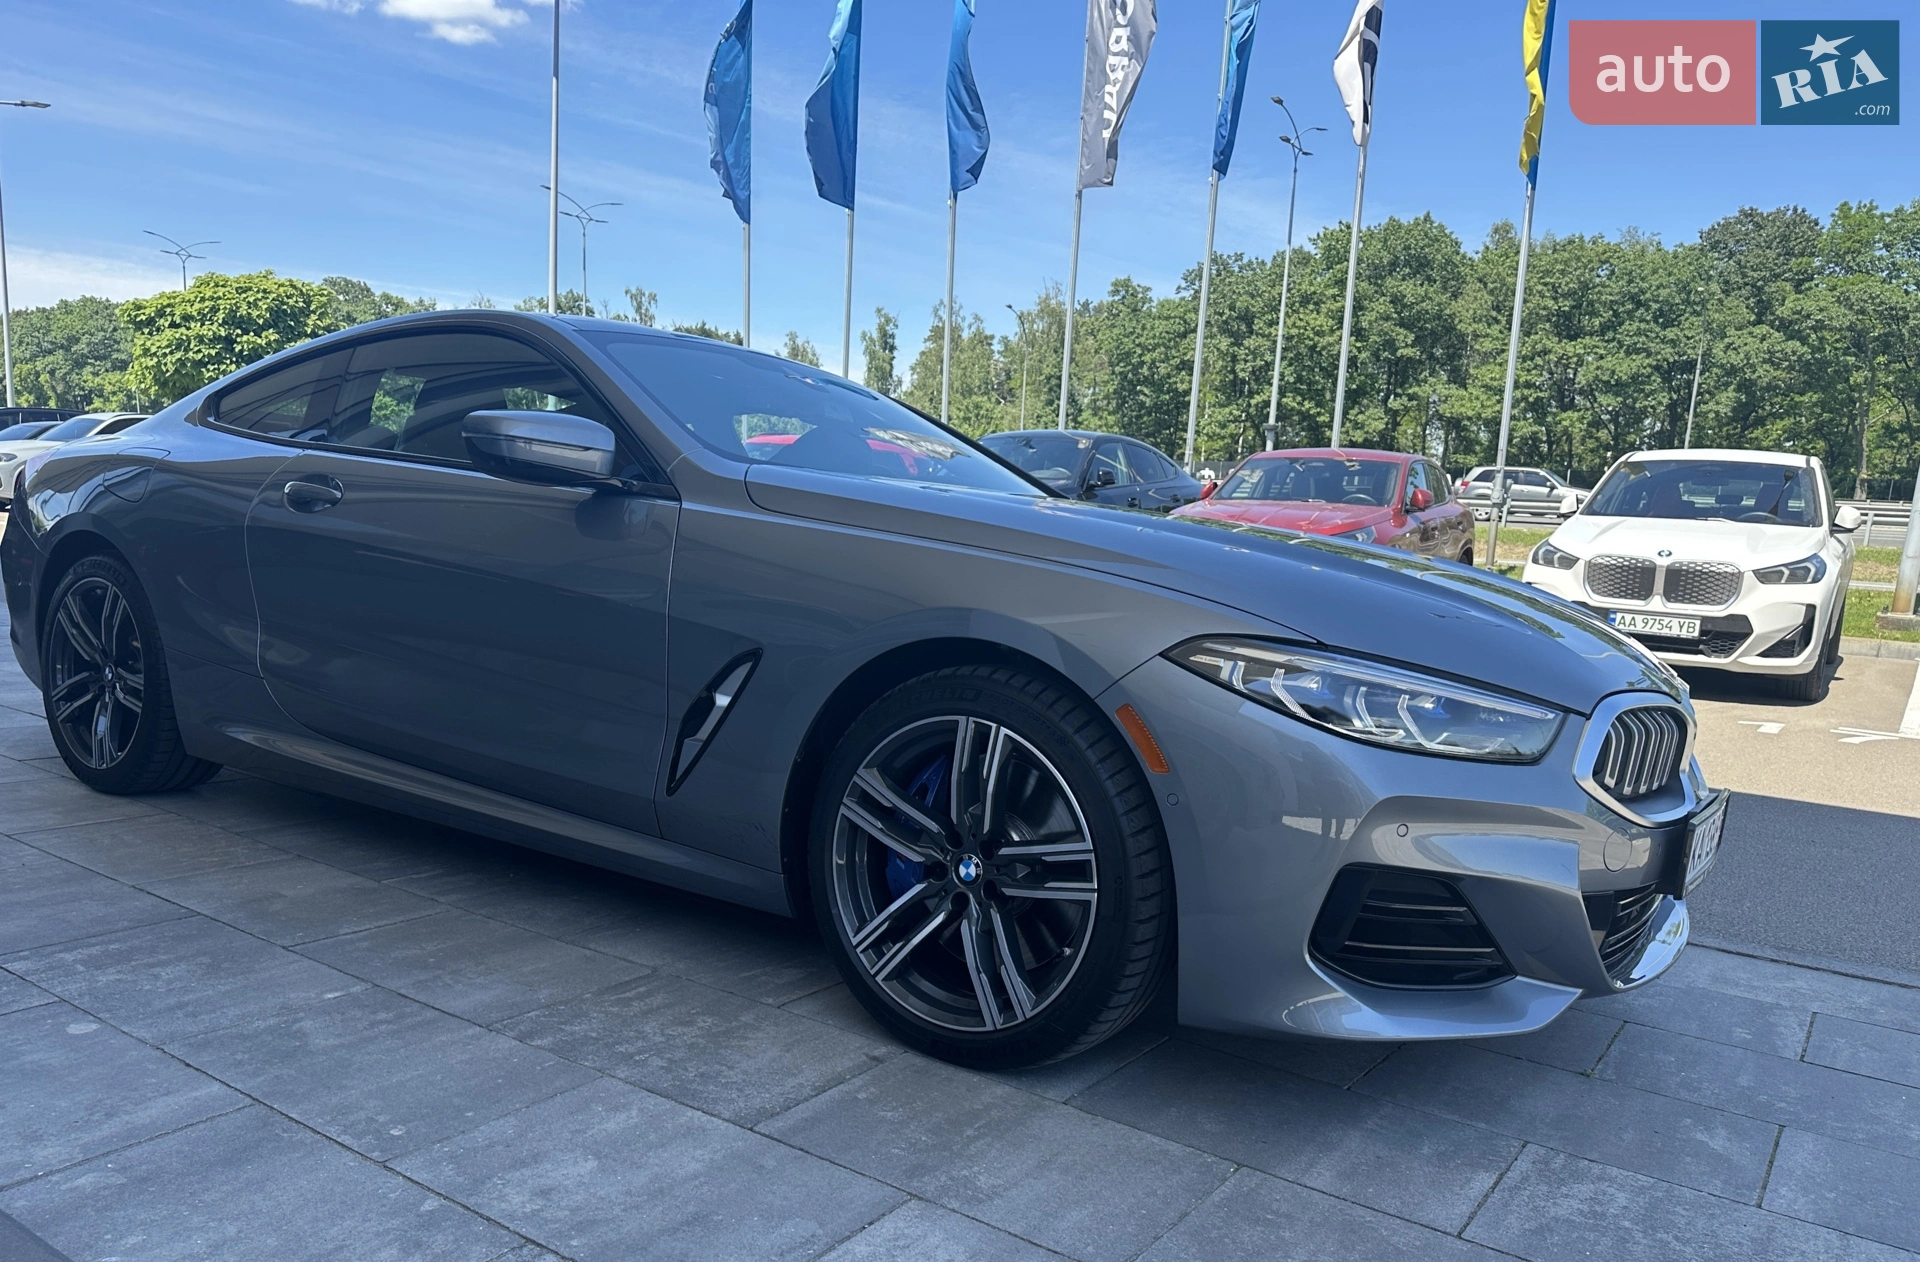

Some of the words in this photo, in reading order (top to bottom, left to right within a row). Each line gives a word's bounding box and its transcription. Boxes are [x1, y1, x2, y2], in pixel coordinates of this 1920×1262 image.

[1617, 615, 1637, 629] AA
[1641, 617, 1673, 632] 9754
[1678, 620, 1697, 634] YB
[1016, 704, 1046, 727] SPORT
